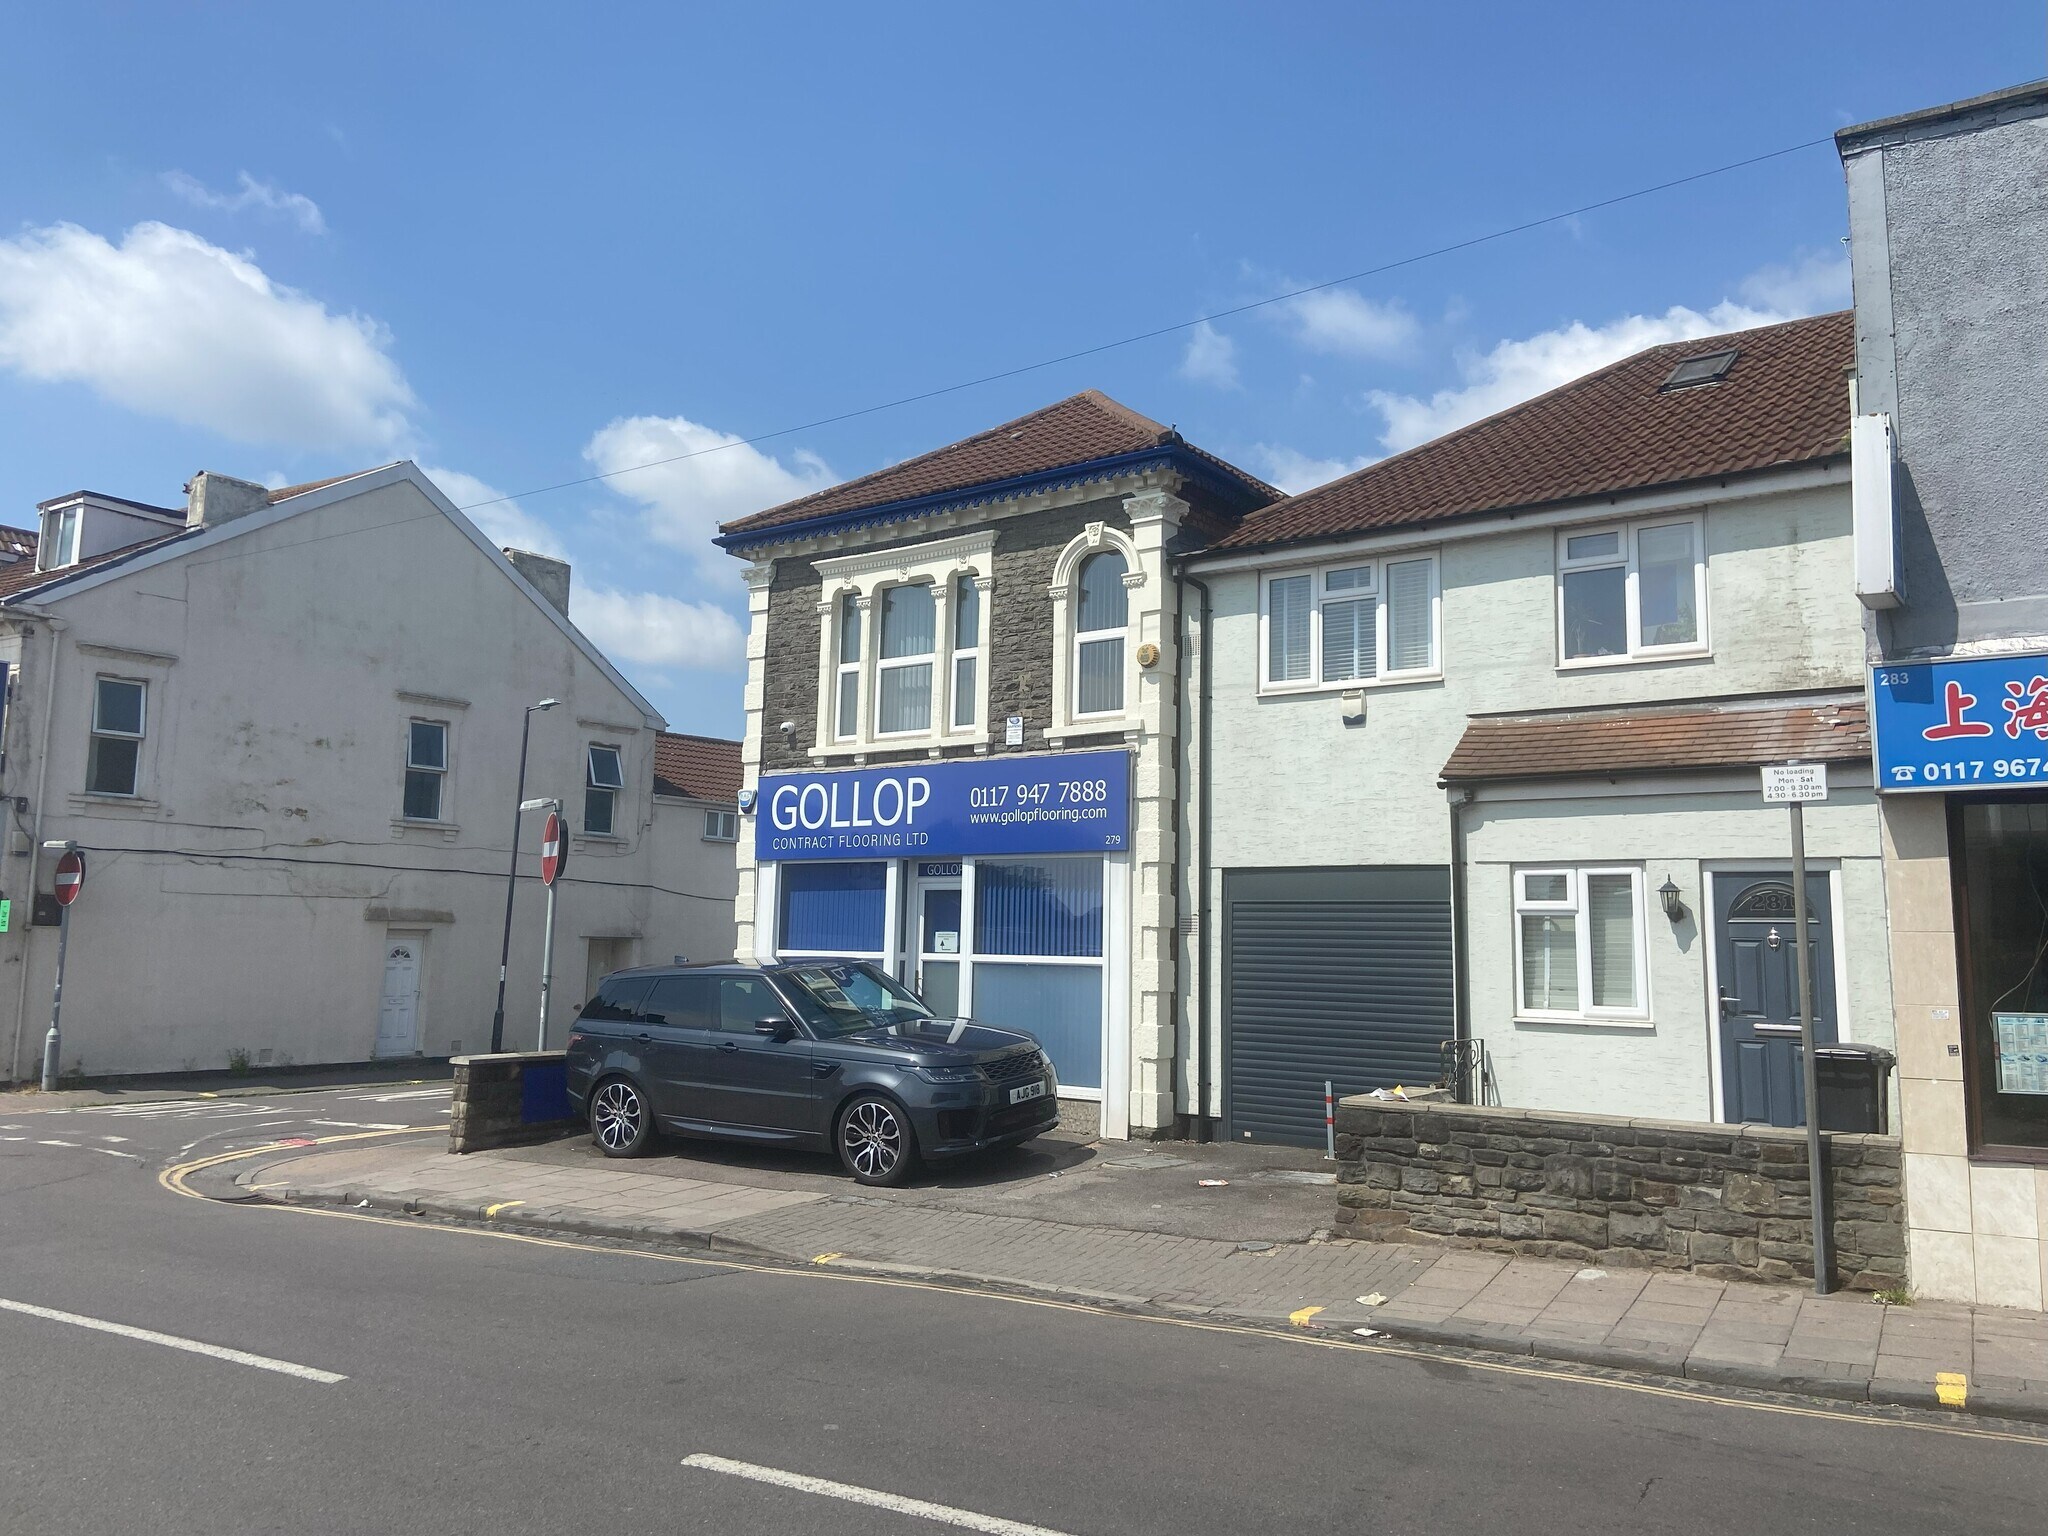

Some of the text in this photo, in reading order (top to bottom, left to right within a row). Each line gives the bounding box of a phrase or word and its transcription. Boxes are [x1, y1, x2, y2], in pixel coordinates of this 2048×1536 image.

[1880, 672, 1909, 686] 283
[1923, 760, 1984, 781] 0117
[970, 779, 1107, 808] 0117 947 7888
[771, 777, 931, 831] GOLLOP
[970, 806, 1107, 826] www.gollopflooring.com
[772, 832, 929, 850] CONTRACT FLOORING LTD
[1105, 835, 1121, 845] 279
[1749, 894, 1795, 911] 281
